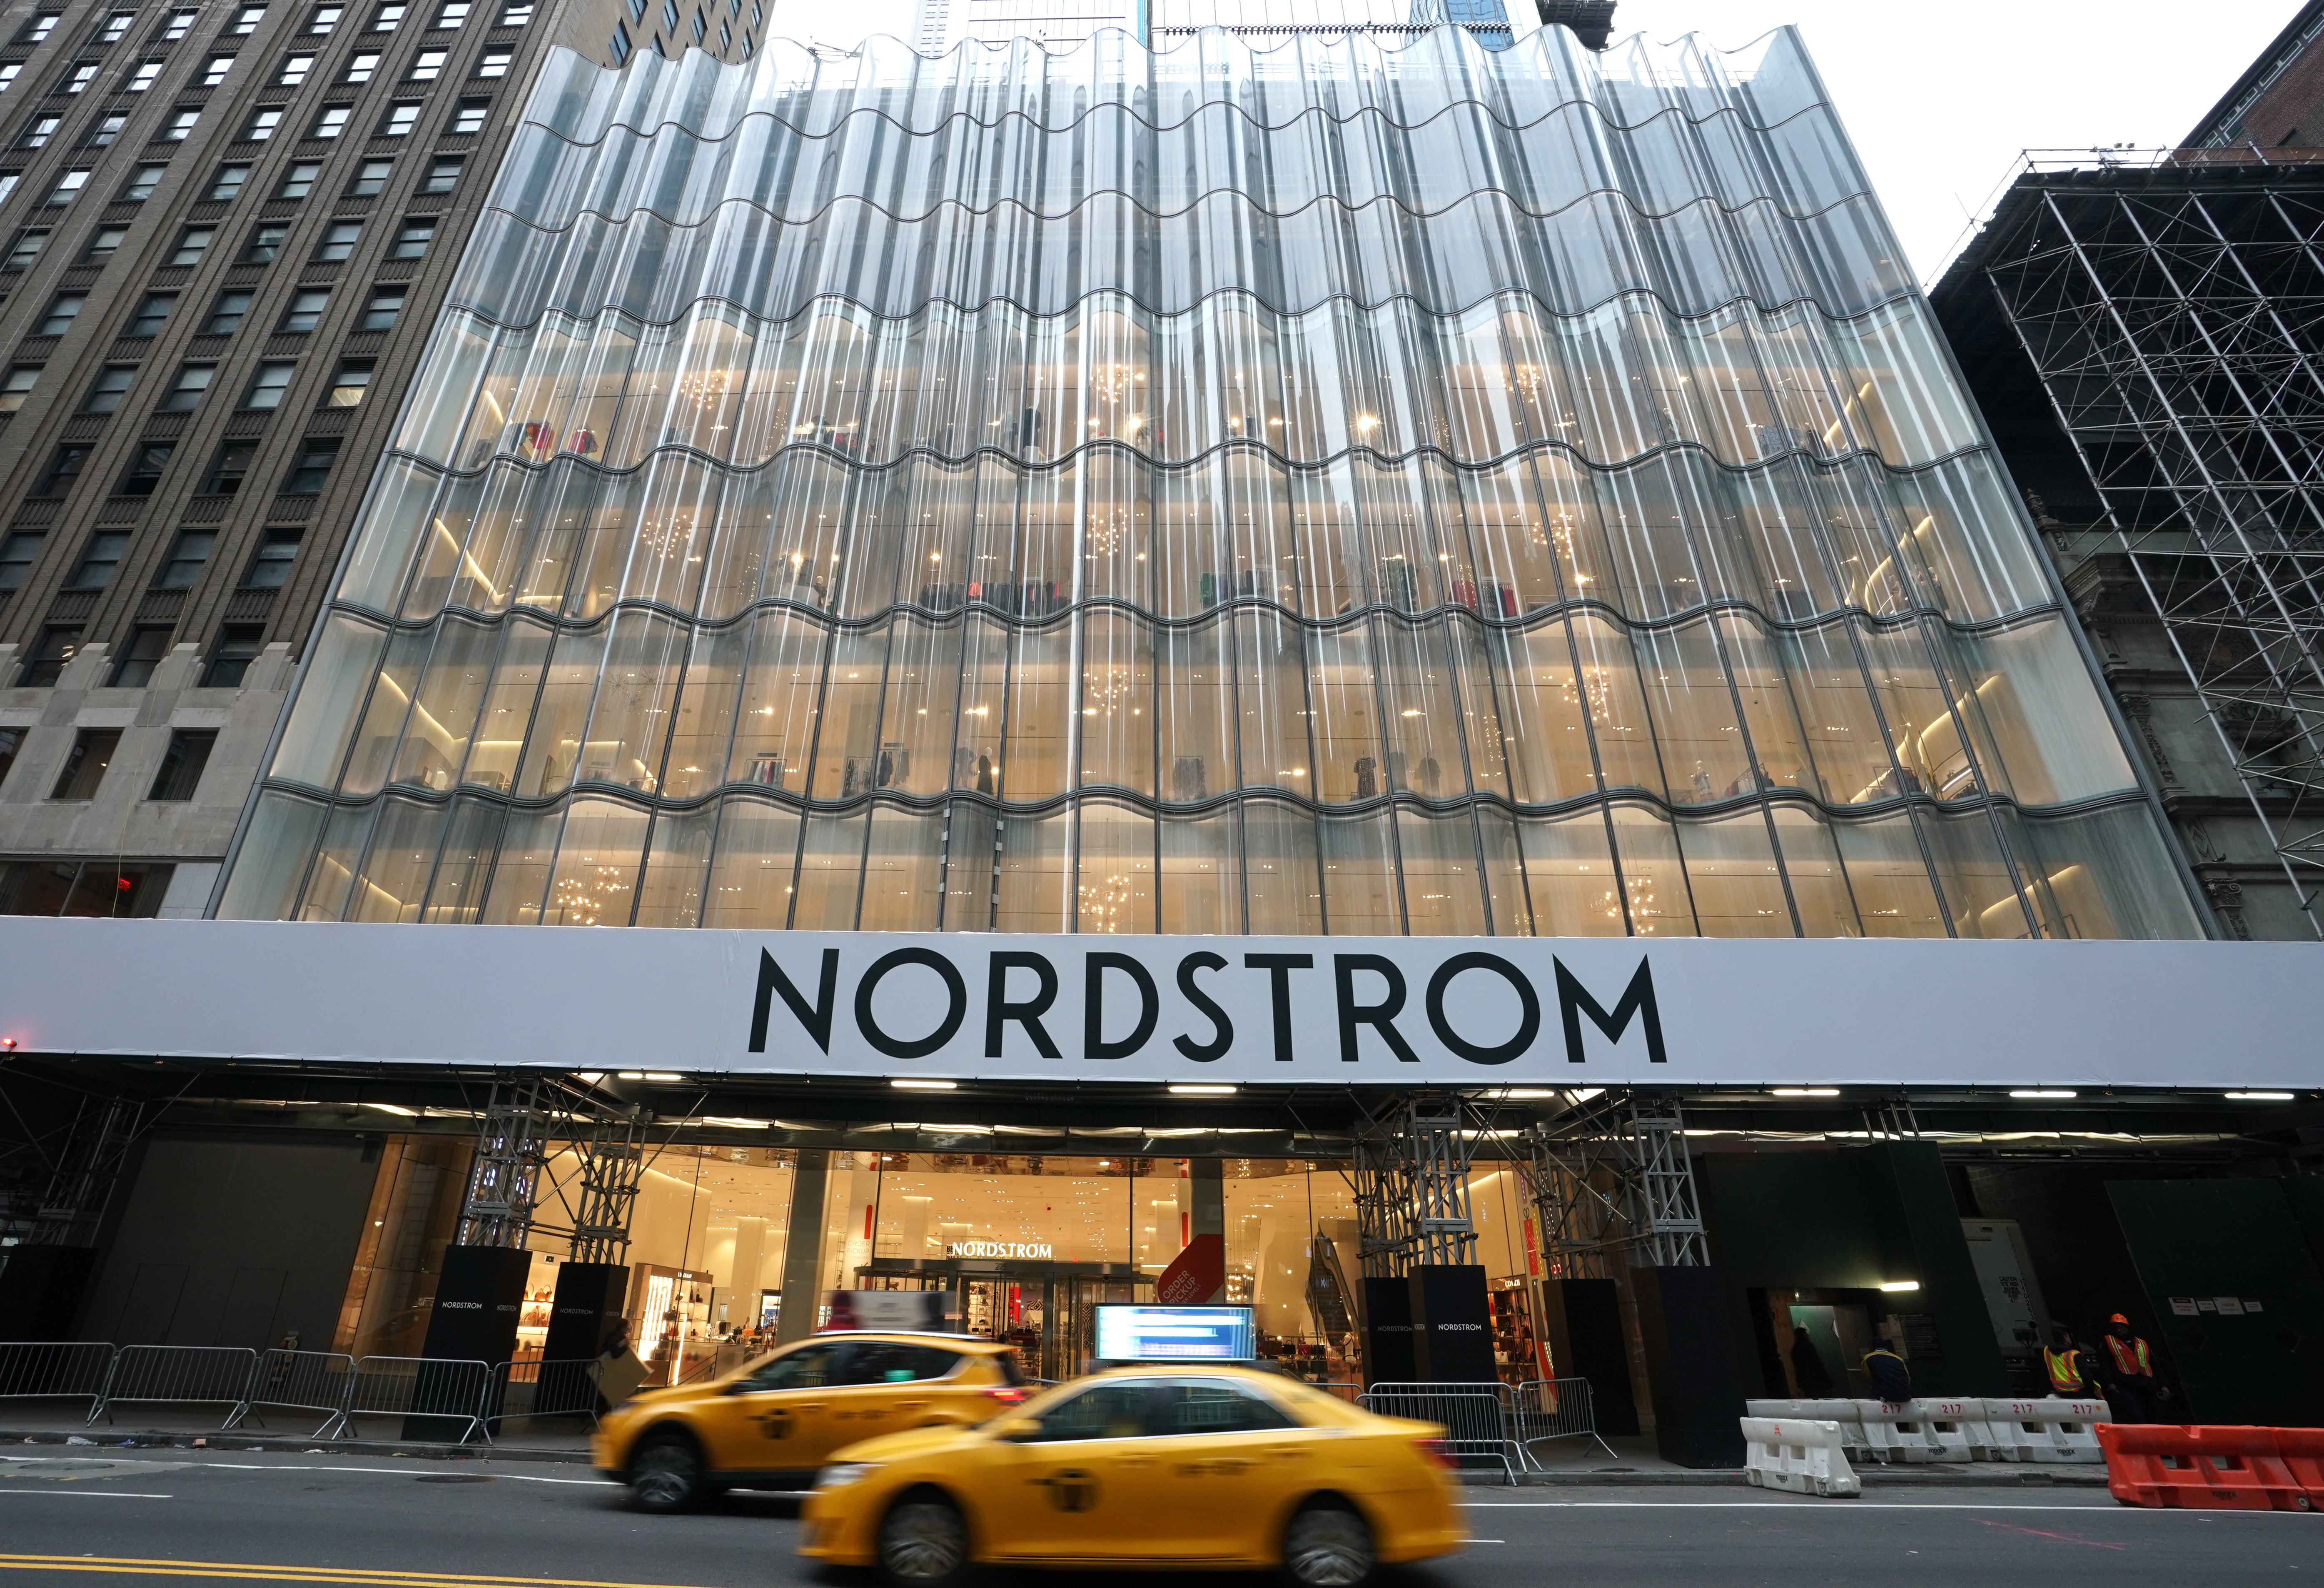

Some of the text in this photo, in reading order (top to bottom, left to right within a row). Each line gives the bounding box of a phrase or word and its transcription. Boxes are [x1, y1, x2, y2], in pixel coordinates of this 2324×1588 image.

[748, 946, 1667, 1065] NORDSTROM
[953, 1242, 1051, 1258] NORDSTROM
[1163, 1270, 1190, 1299] ORDER
[1188, 1287, 1199, 1298] LEVEL
[1882, 1404, 1901, 1413] 217
[1942, 1404, 1961, 1413] 217
[2013, 1404, 2032, 1413] 217
[2072, 1404, 2092, 1413] 217
